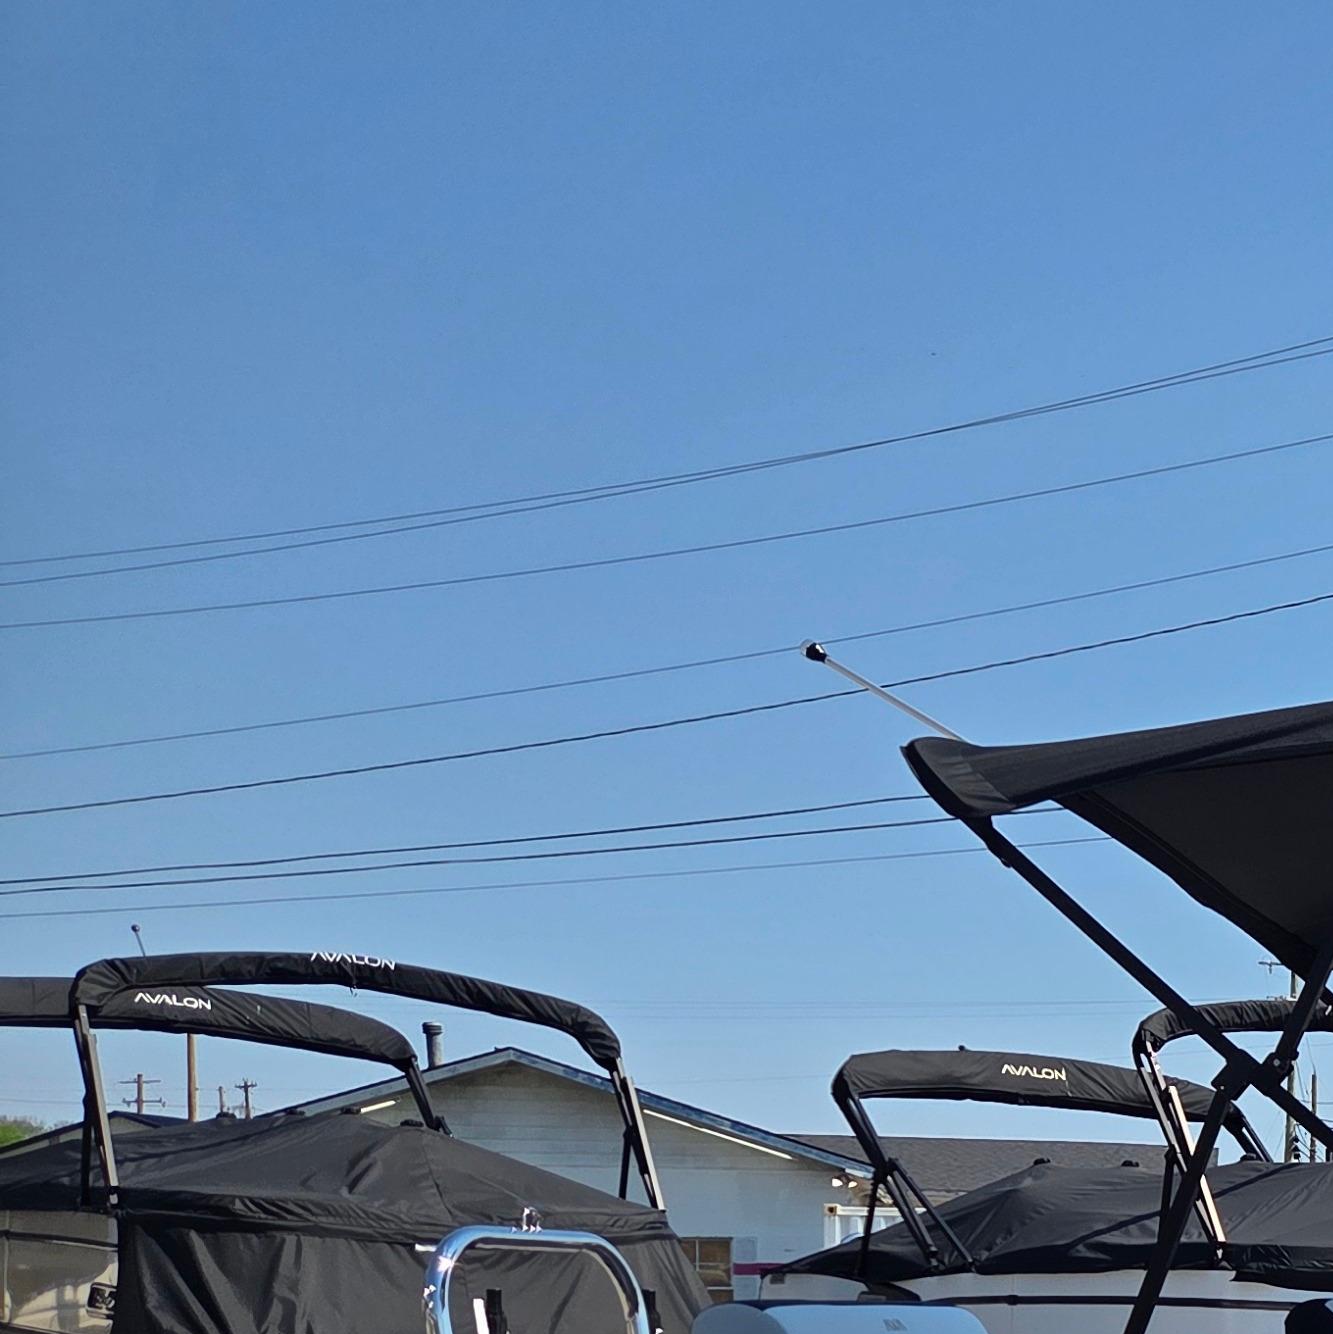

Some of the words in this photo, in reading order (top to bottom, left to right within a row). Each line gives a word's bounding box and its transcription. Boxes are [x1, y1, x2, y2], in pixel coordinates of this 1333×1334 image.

[310, 952, 396, 970] AVALON
[134, 992, 212, 1010] AVALON
[1001, 1063, 1067, 1081] AVALON
